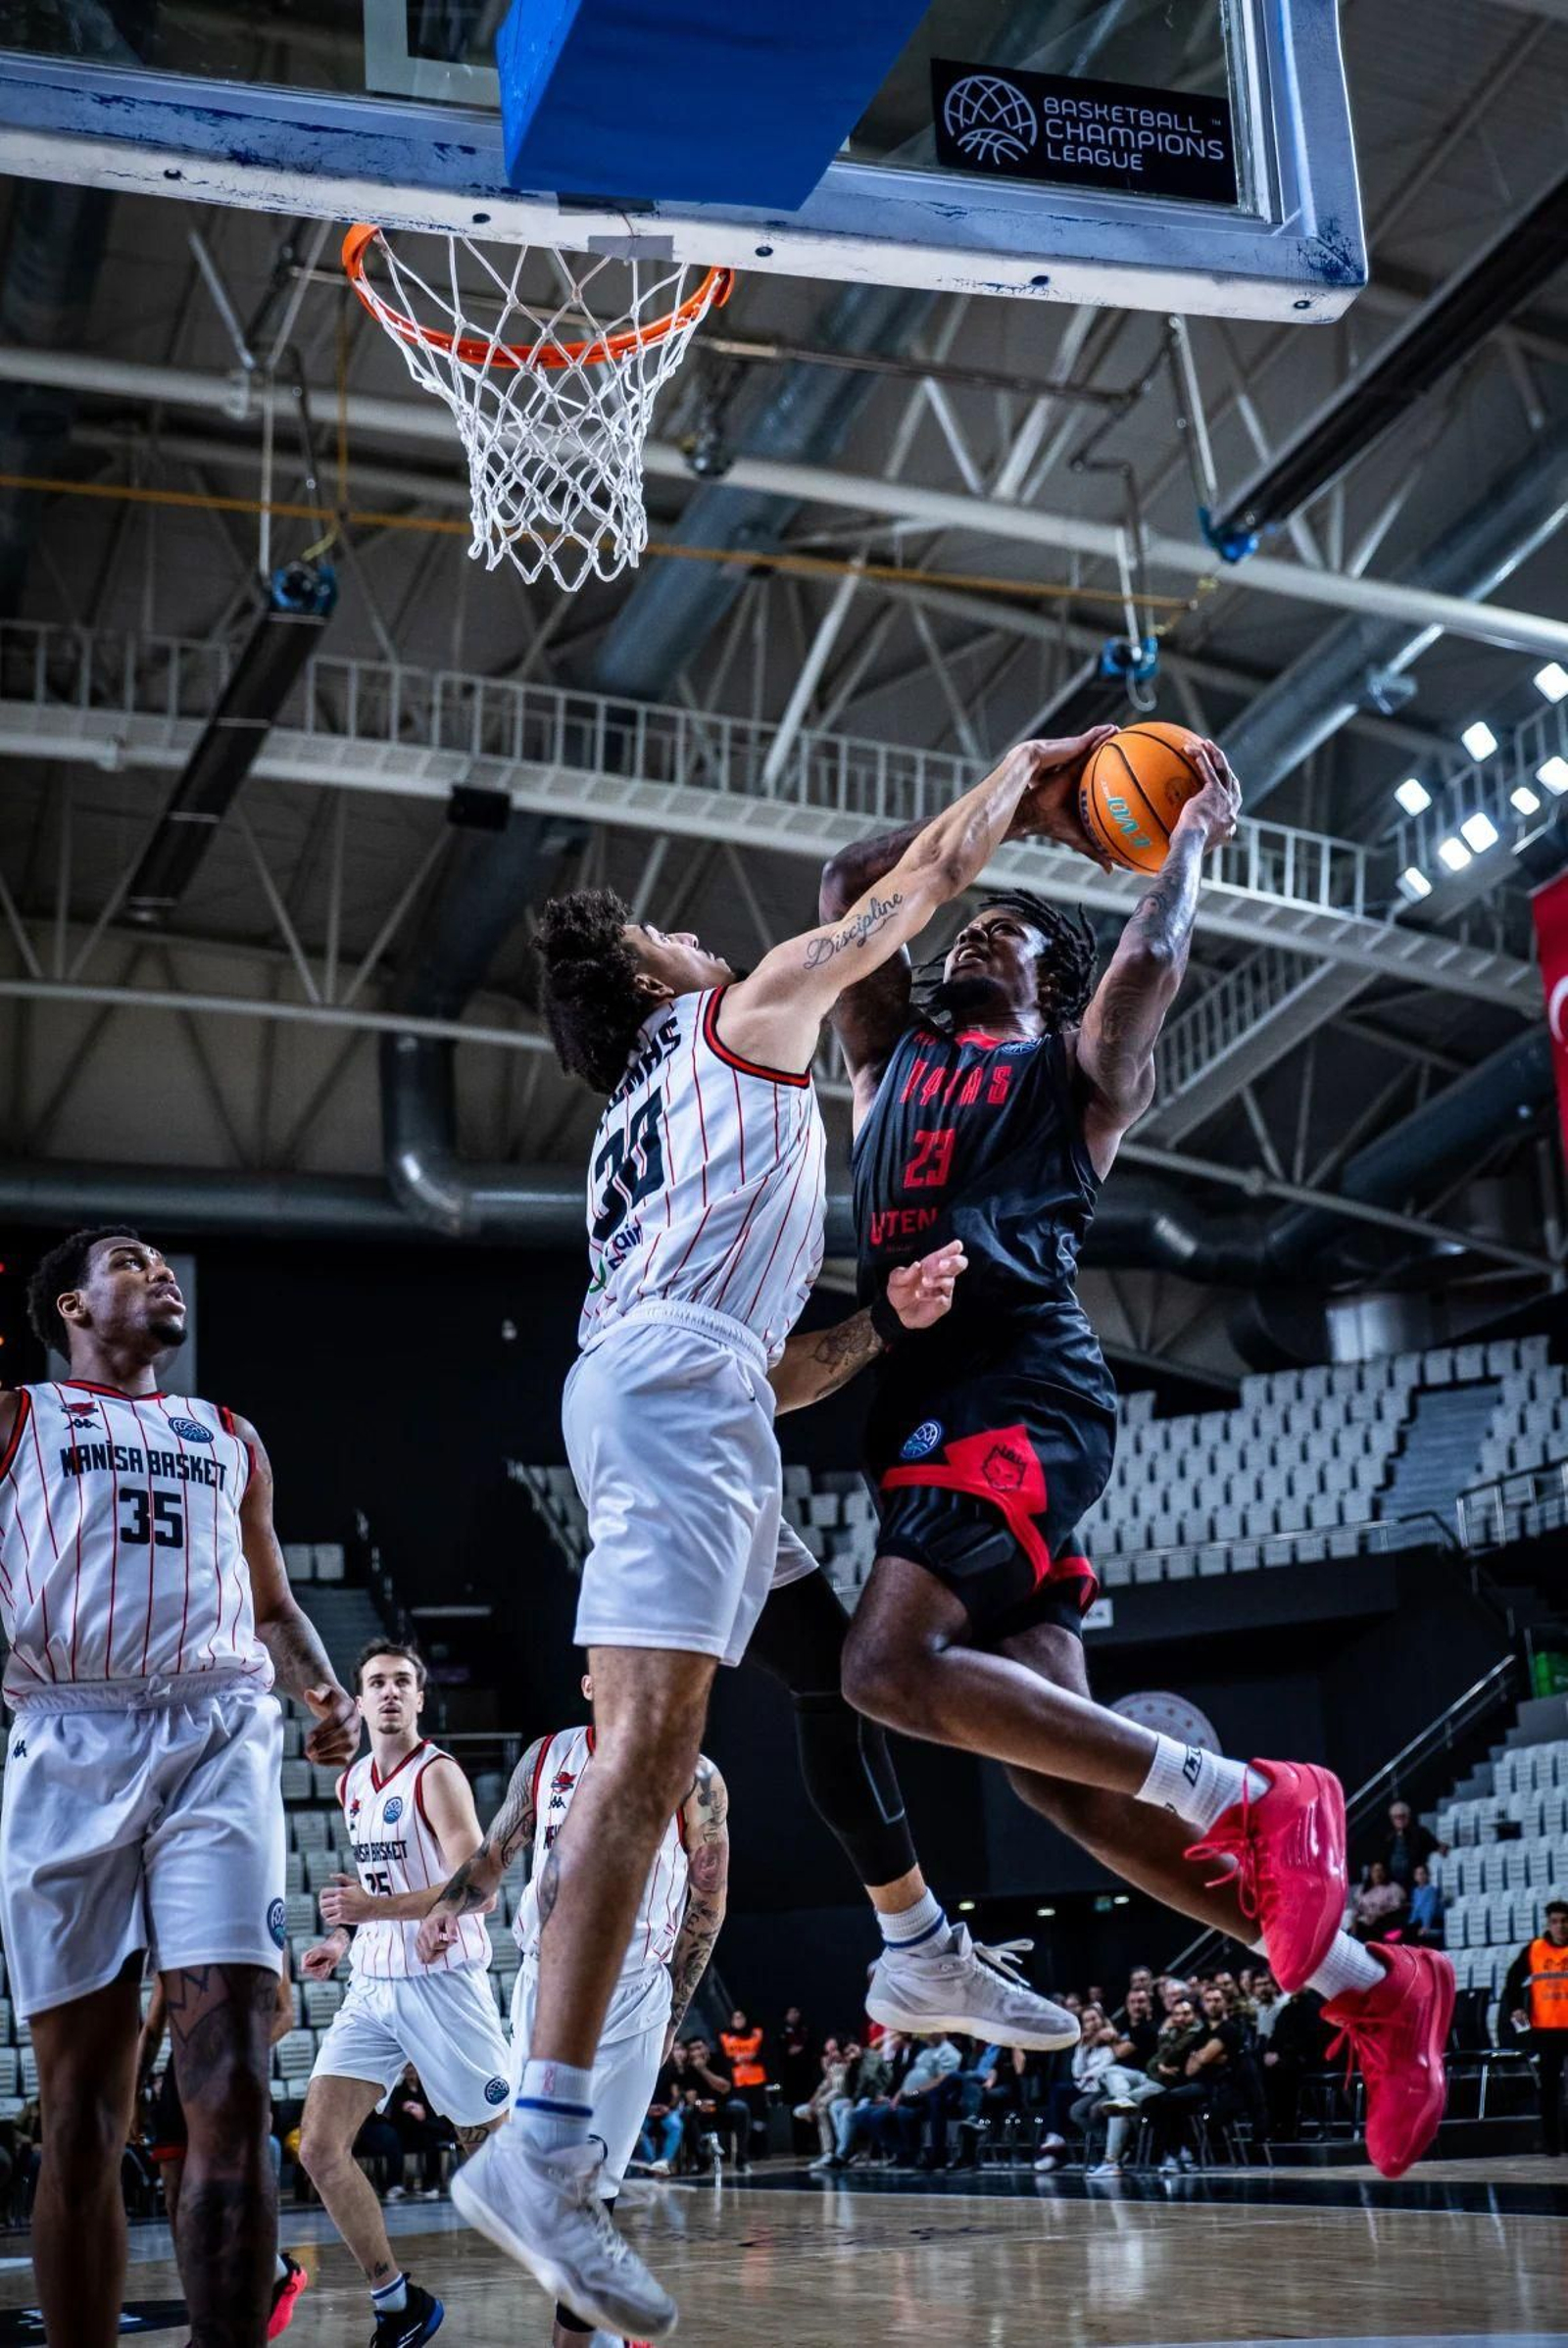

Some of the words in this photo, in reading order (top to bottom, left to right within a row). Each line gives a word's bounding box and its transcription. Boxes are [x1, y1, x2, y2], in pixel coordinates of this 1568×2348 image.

[1044, 97, 1202, 133] BASKETBALL
[1046, 119, 1225, 160] CHAMPIONS
[1047, 142, 1144, 171] LEAGUE
[803, 893, 904, 970] Discipline
[591, 1085, 665, 1243] 30
[904, 1127, 956, 1190] 23
[147, 1449, 228, 1492] BASKET
[118, 1487, 184, 1549] 35
